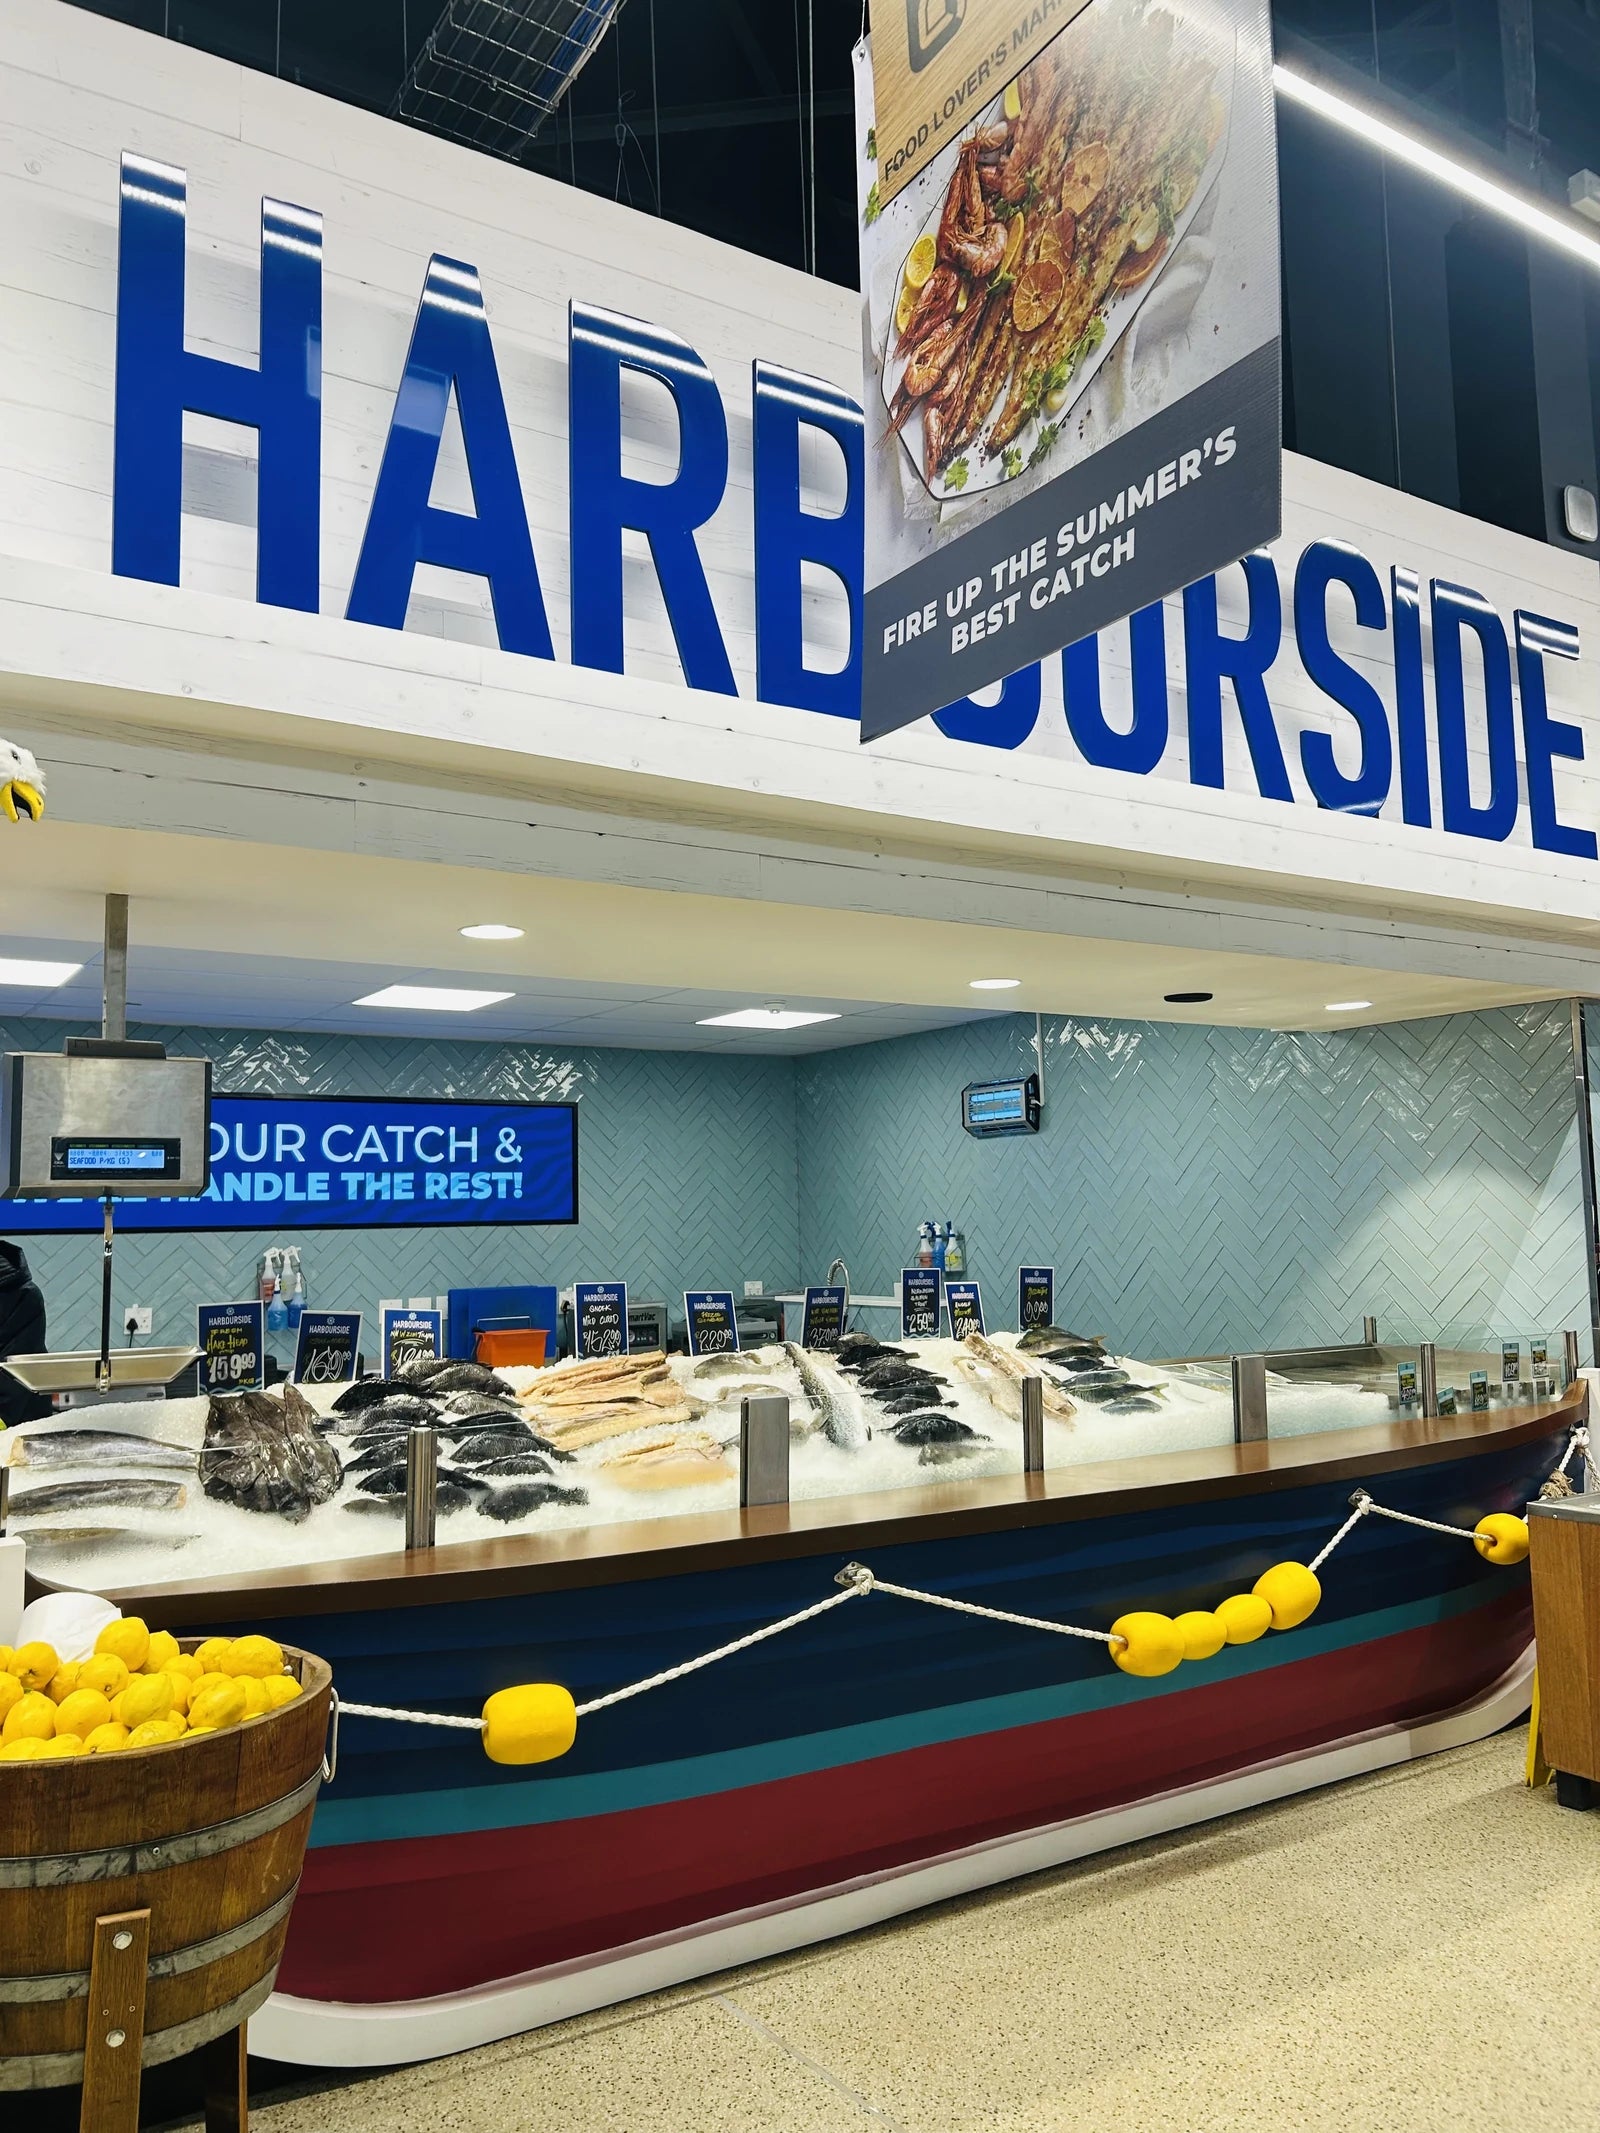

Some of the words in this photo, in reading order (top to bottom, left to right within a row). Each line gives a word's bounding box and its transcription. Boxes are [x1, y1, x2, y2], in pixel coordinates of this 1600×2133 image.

[884, 124, 929, 182] FOOD
[933, 42, 1008, 132] LOVER'S
[1012, 0, 1063, 52] MAR
[113, 151, 1598, 860] HARBURSIDE
[883, 600, 937, 654] FIRE
[946, 577, 982, 617] UP
[991, 537, 1047, 593] THE
[1057, 426, 1237, 557] SUMMER'S
[951, 592, 1021, 654] BEST
[1030, 527, 1135, 610] CATCH
[321, 1124, 478, 1163] CATCH
[494, 1127, 523, 1162] &
[69, 1157, 97, 1165] SEAFOOD
[341, 1172, 415, 1201] THE
[425, 1172, 523, 1200] REST!
[583, 1293, 619, 1302] HARBOURSIDE
[208, 1315, 253, 1326] HARBOURSIDE
[308, 1325, 351, 1335] HARBOURSIDE
[392, 1320, 433, 1329] HARBOURSIDE
